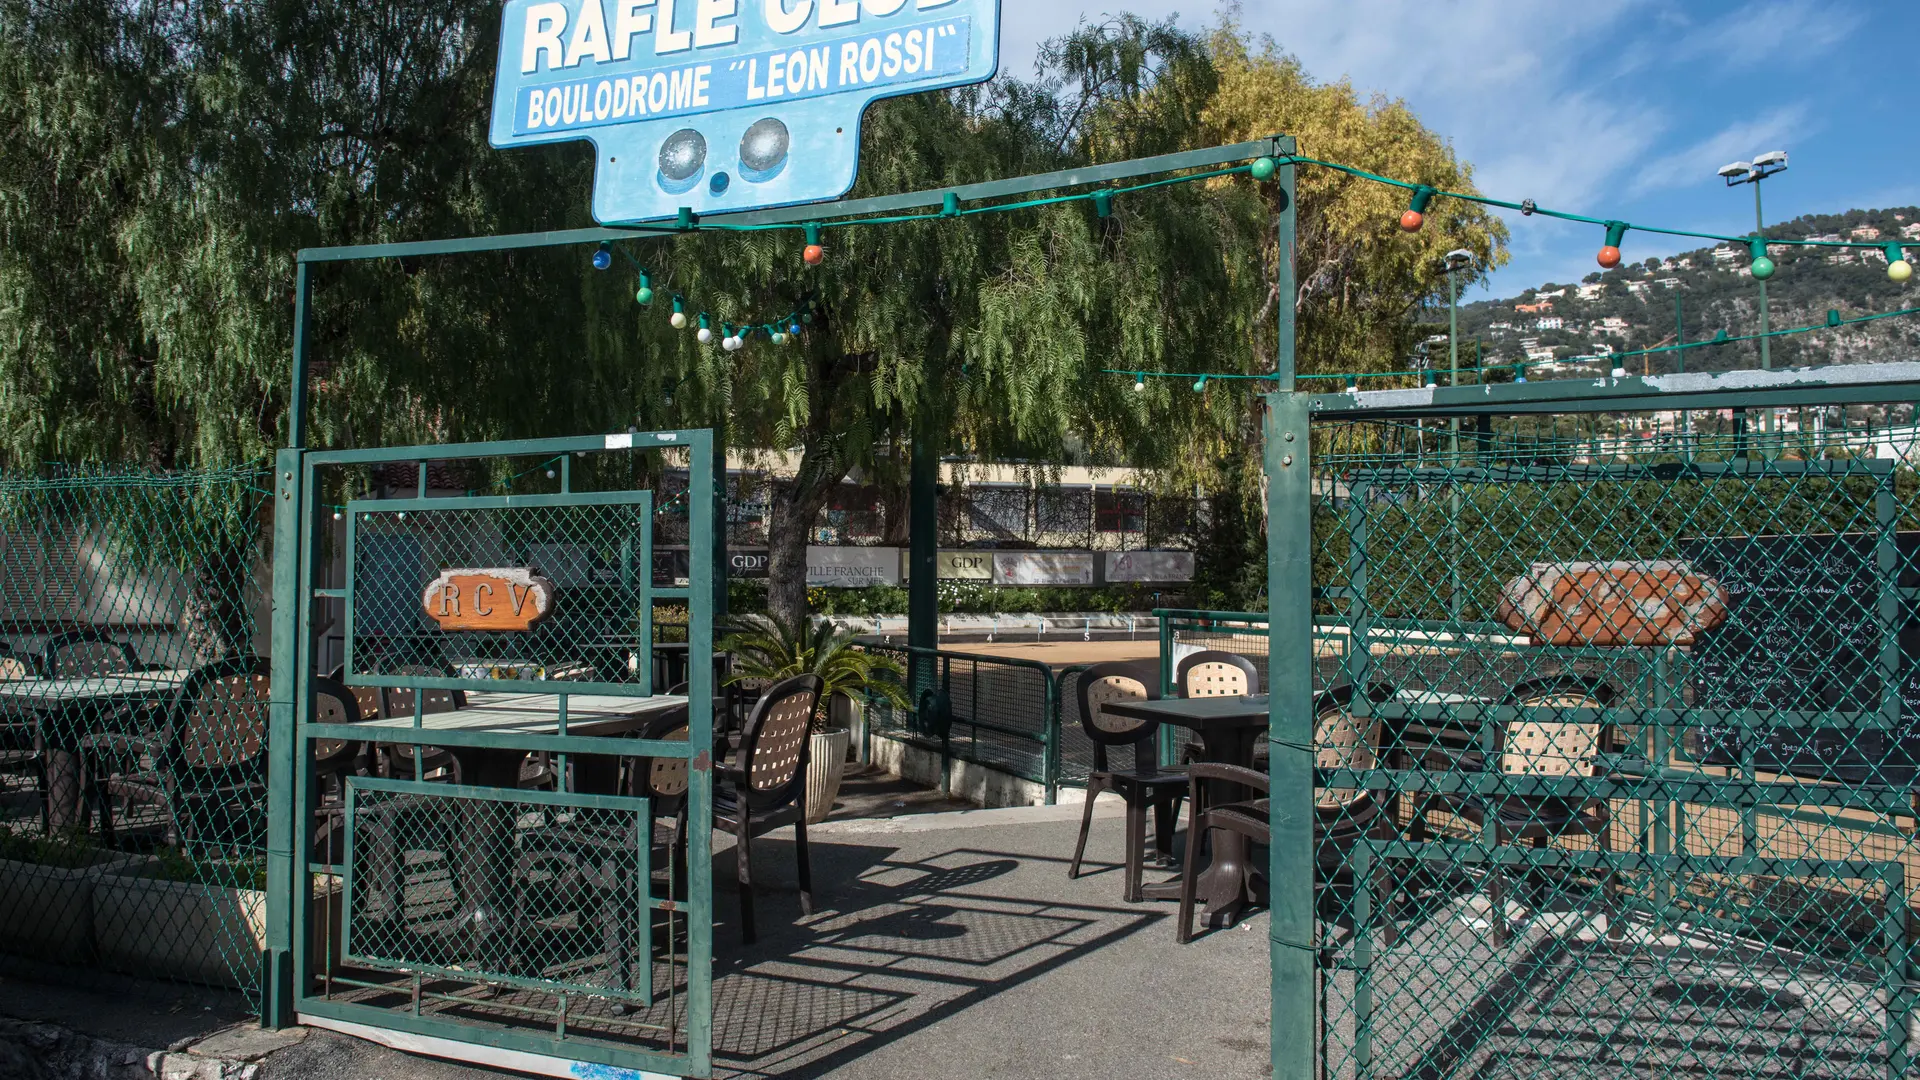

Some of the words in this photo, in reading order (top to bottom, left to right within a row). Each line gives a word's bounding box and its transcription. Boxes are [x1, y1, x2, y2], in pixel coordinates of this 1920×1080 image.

[521, 0, 739, 74] RAFLE
[526, 64, 712, 129] BOULODROME
[731, 555, 768, 568] GDP
[951, 556, 983, 569] GDP
[834, 566, 884, 577] FRANCHE
[847, 577, 864, 585] SUR
[866, 577, 884, 585] MER
[986, 633, 993, 643] 4
[1084, 632, 1090, 641] 5
